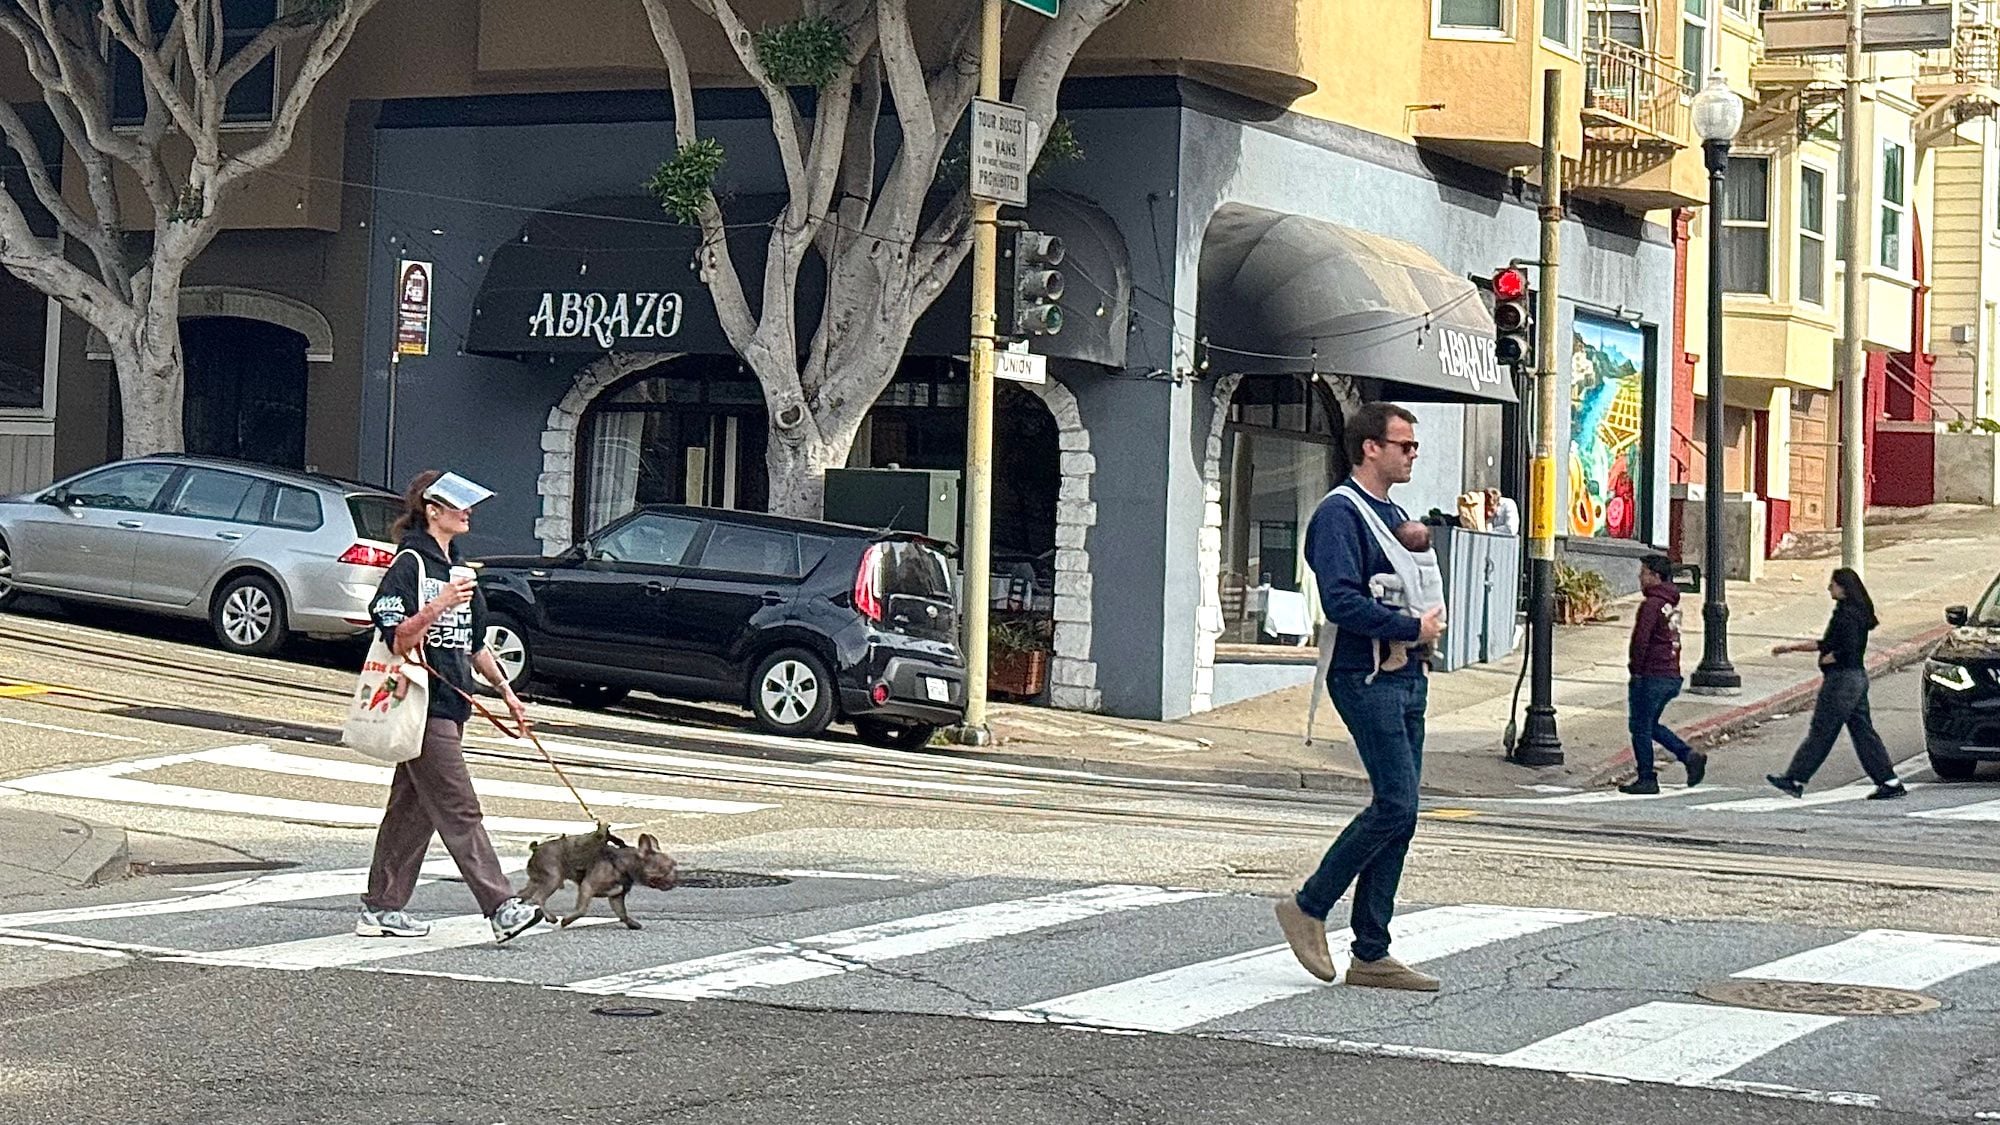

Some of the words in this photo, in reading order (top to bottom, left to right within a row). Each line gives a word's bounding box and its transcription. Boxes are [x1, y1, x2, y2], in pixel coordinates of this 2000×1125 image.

[978, 111, 996, 129] TOUR
[999, 116, 1022, 136] BUSES
[995, 138, 1017, 157] VANS
[978, 169, 1019, 191] PROHIBITED
[529, 292, 683, 348] ABRAZO
[1002, 356, 1032, 375] UNION
